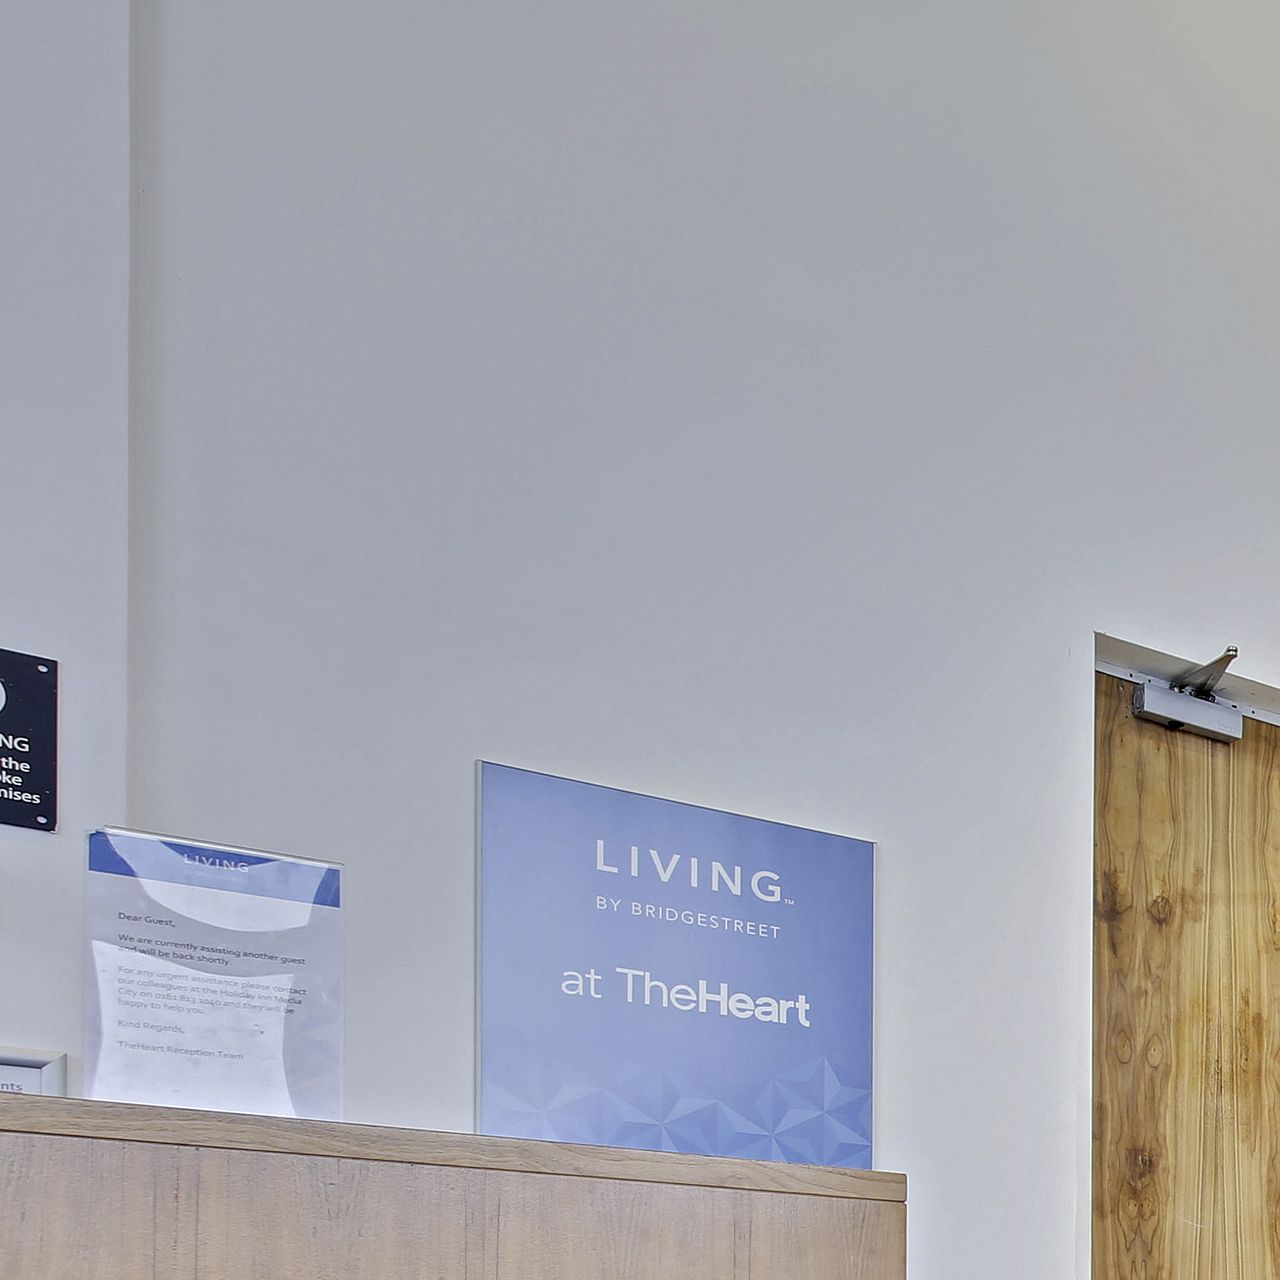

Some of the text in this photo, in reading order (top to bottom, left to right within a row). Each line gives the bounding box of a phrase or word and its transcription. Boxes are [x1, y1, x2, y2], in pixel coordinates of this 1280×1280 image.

[1, 757, 30, 772] the
[0, 771, 22, 786] ke
[184, 854, 249, 873] LIVING
[596, 840, 782, 902] LIVING
[119, 912, 175, 928] Dear Guest,
[596, 896, 780, 939] BY BRIDGESTREET
[119, 934, 305, 965] We are currently assisting another guest
[158, 950, 172, 958] be
[174, 951, 194, 961] back
[197, 955, 232, 967] shortly.
[561, 967, 811, 1027] at TheHeart
[118, 1019, 140, 1028] Kind
[166, 1046, 214, 1058] Reception
[217, 1051, 244, 1060] Team
